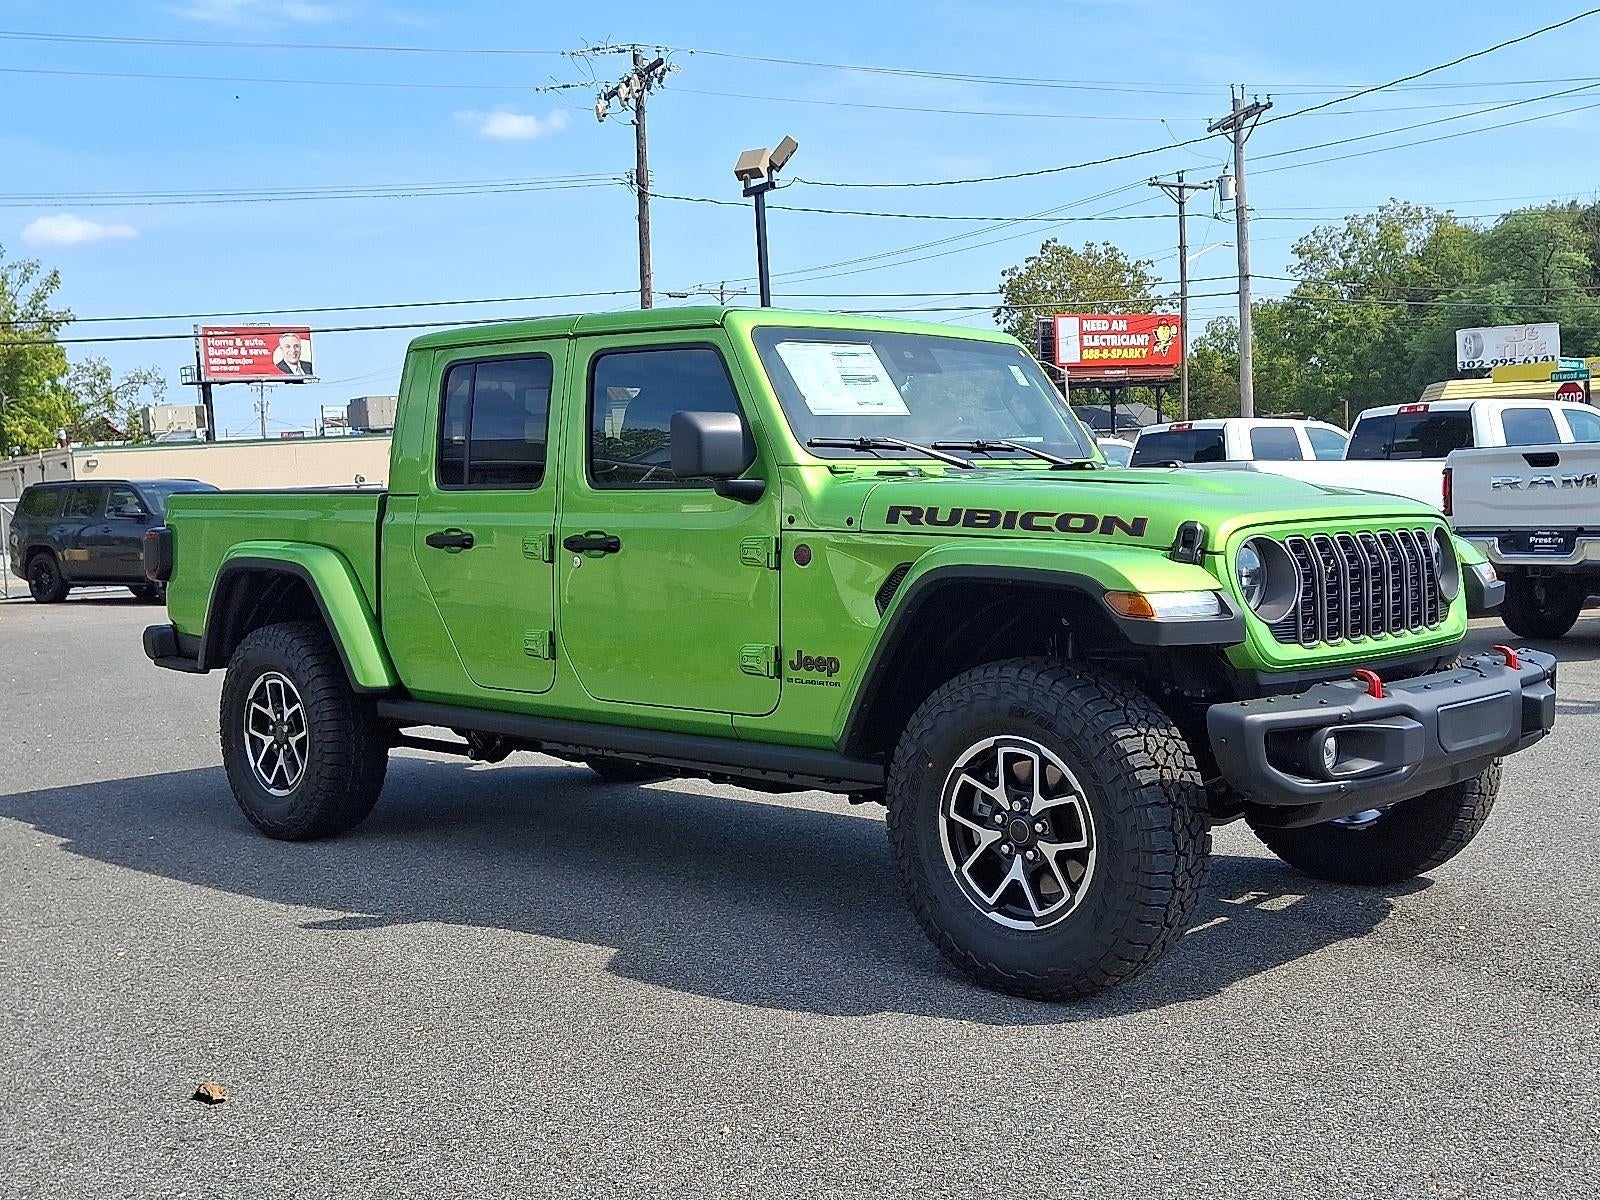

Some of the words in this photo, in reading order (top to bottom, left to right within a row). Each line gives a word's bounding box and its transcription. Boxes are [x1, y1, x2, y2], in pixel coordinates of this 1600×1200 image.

[1083, 320, 1110, 331] NEED
[1111, 319, 1127, 331] AN
[207, 337, 234, 346] Home
[1084, 335, 1149, 346] ELECTRICIAN?
[208, 347, 239, 356] Bundle
[1495, 341, 1547, 358] TIRE
[1458, 355, 1555, 369] 302-995-6141
[1557, 391, 1583, 402] STOP
[1491, 473, 1598, 491] RAM
[885, 505, 1149, 537] RUBICON
[788, 649, 840, 677] Jeep
[794, 678, 841, 687] GLADIATOR
